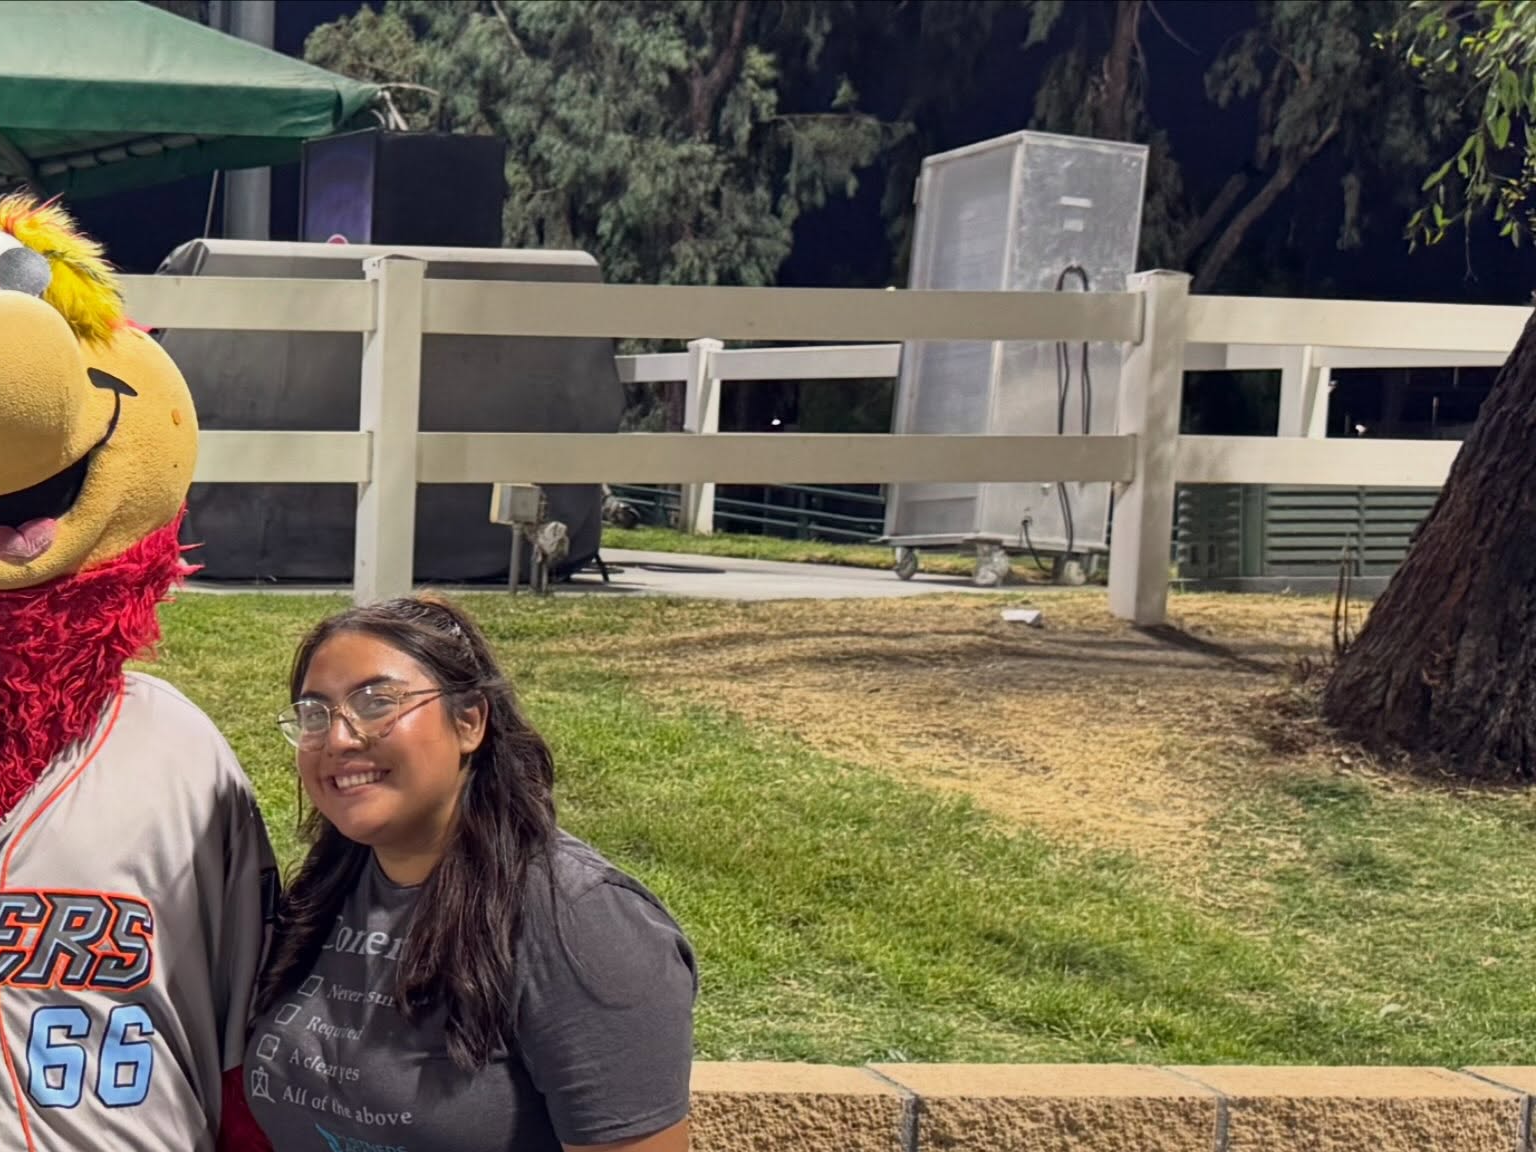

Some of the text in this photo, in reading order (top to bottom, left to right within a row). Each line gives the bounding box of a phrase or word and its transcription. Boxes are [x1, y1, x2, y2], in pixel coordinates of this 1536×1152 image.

[307, 1016, 364, 1041] Required
[26, 1005, 154, 1108] 66
[289, 1048, 300, 1065] A
[338, 1063, 360, 1083] yes
[282, 1086, 413, 1127] All of the above
